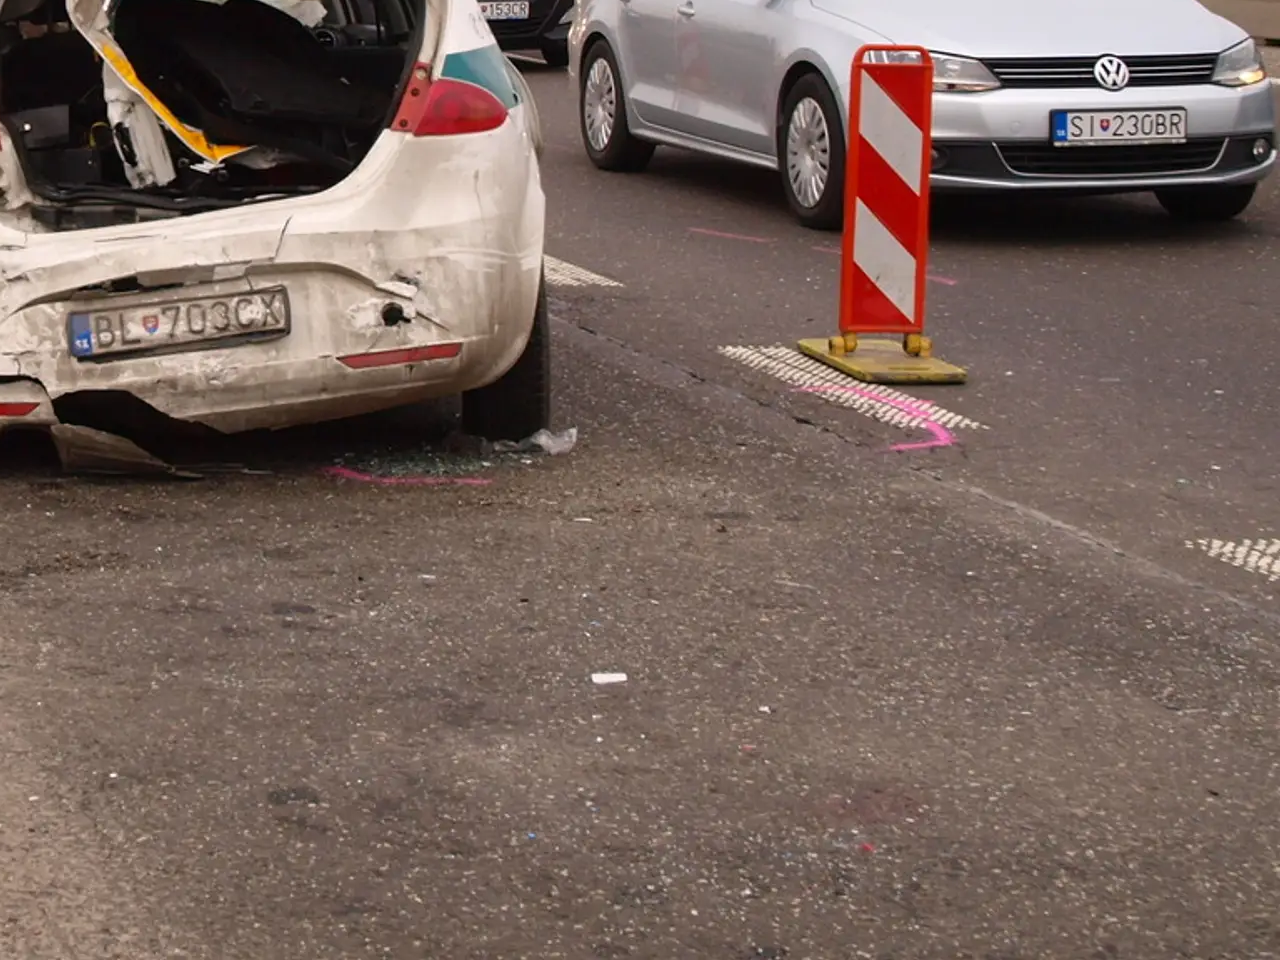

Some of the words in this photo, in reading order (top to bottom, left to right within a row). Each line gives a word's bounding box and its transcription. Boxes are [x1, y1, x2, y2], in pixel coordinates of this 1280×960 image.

[489, 1, 527, 17] 153CR
[1070, 115, 1094, 138] SI
[1111, 113, 1183, 138] 230BR
[93, 313, 141, 349] BL
[160, 293, 280, 338] 703CX
